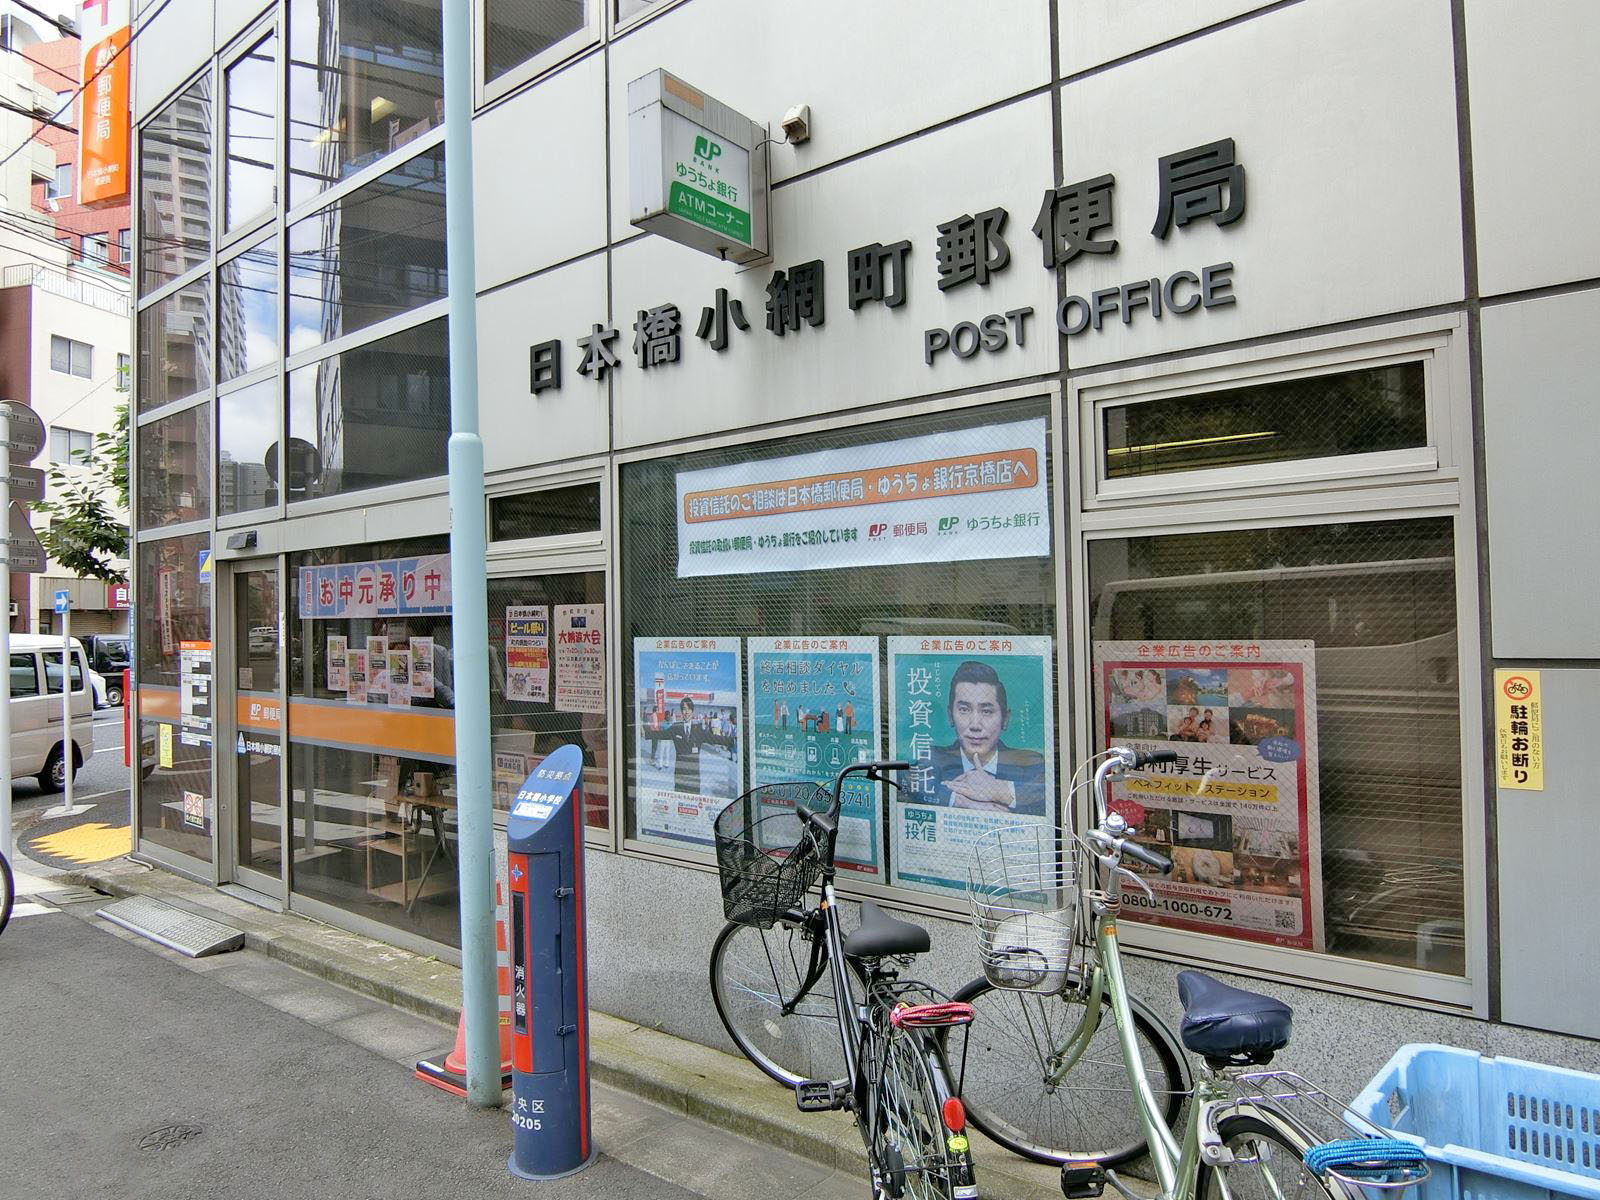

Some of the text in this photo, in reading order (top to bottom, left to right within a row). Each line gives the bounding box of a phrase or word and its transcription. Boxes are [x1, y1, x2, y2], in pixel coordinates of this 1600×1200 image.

[97, 74, 112, 141] 郵便局
[694, 135, 722, 161] JP
[693, 156, 720, 174] BANK
[676, 161, 738, 202] ゆうちょ銀行
[678, 191, 744, 225] ATMコーナー
[529, 137, 1246, 395] 日本橋小網町郵便局
[924, 262, 1237, 365] POST OFFICE
[892, 521, 929, 538] 郵便局
[966, 511, 1041, 532] ゆうちょ銀行
[319, 568, 442, 607] お中元承り中
[656, 640, 716, 649] 企業広告のご案内
[774, 640, 848, 650] 企業広告のご案内
[920, 640, 1012, 652] 企業広告のご案内
[1137, 644, 1262, 658] 企業広告のご案内
[761, 660, 864, 676] 終活相談ダイヤル
[761, 681, 836, 696] を始めました
[907, 667, 936, 795] 投資信託
[1510, 704, 1529, 784] 駐輪お断り
[536, 768, 573, 781] 防災拠点
[517, 790, 563, 805] 日本橋小学校
[905, 822, 937, 842] 投信
[1122, 893, 1233, 921] 0800-1000-672
[515, 964, 526, 1017] 消火器
